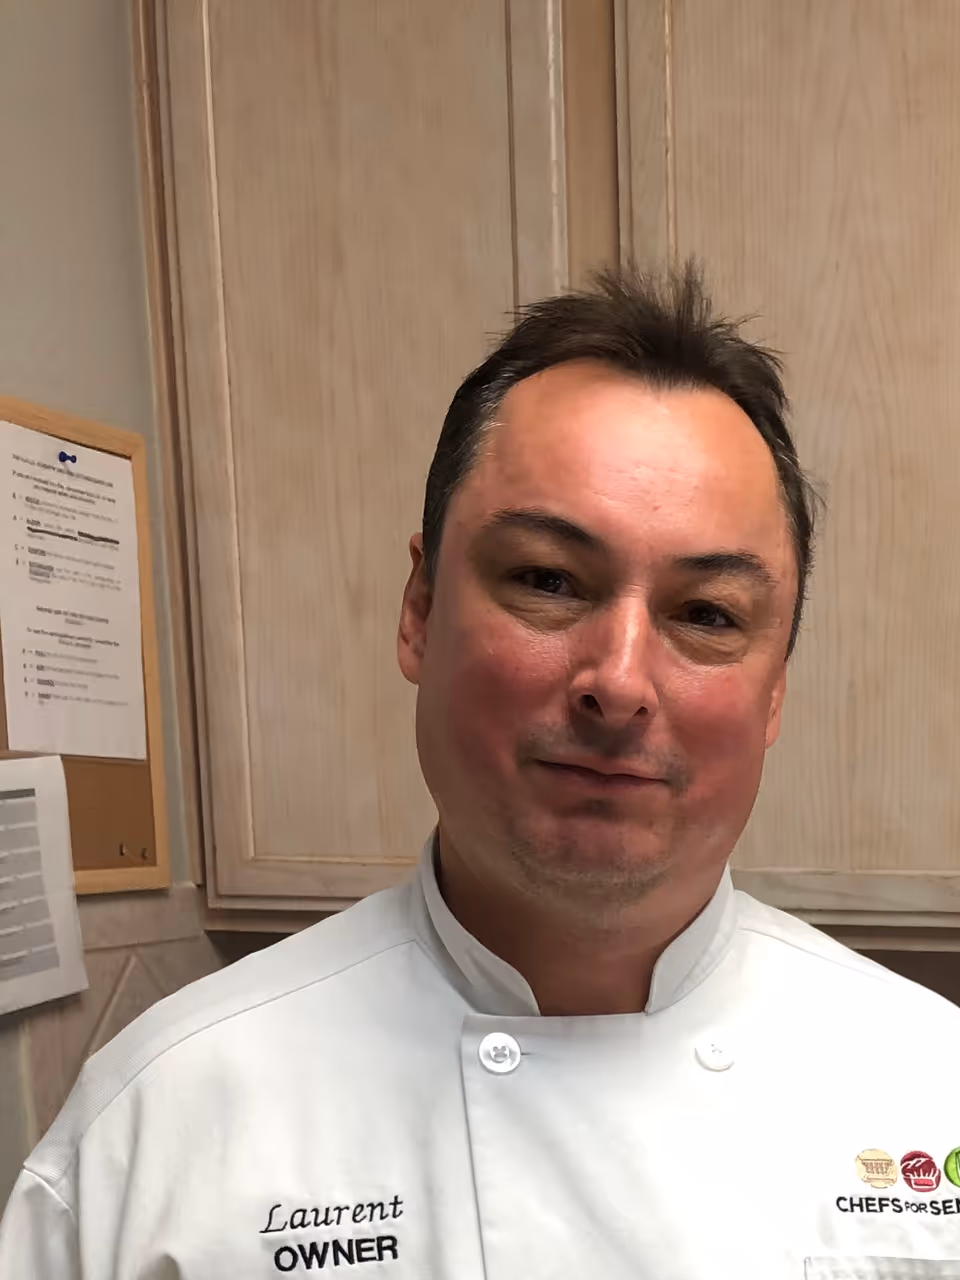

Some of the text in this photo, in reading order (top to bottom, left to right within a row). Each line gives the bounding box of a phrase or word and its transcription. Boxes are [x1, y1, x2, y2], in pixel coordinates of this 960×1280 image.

[258, 1195, 404, 1234] Laurent
[836, 1196, 903, 1214] CHEFS
[905, 1201, 929, 1213] FOR
[274, 1235, 399, 1272] OWNER
